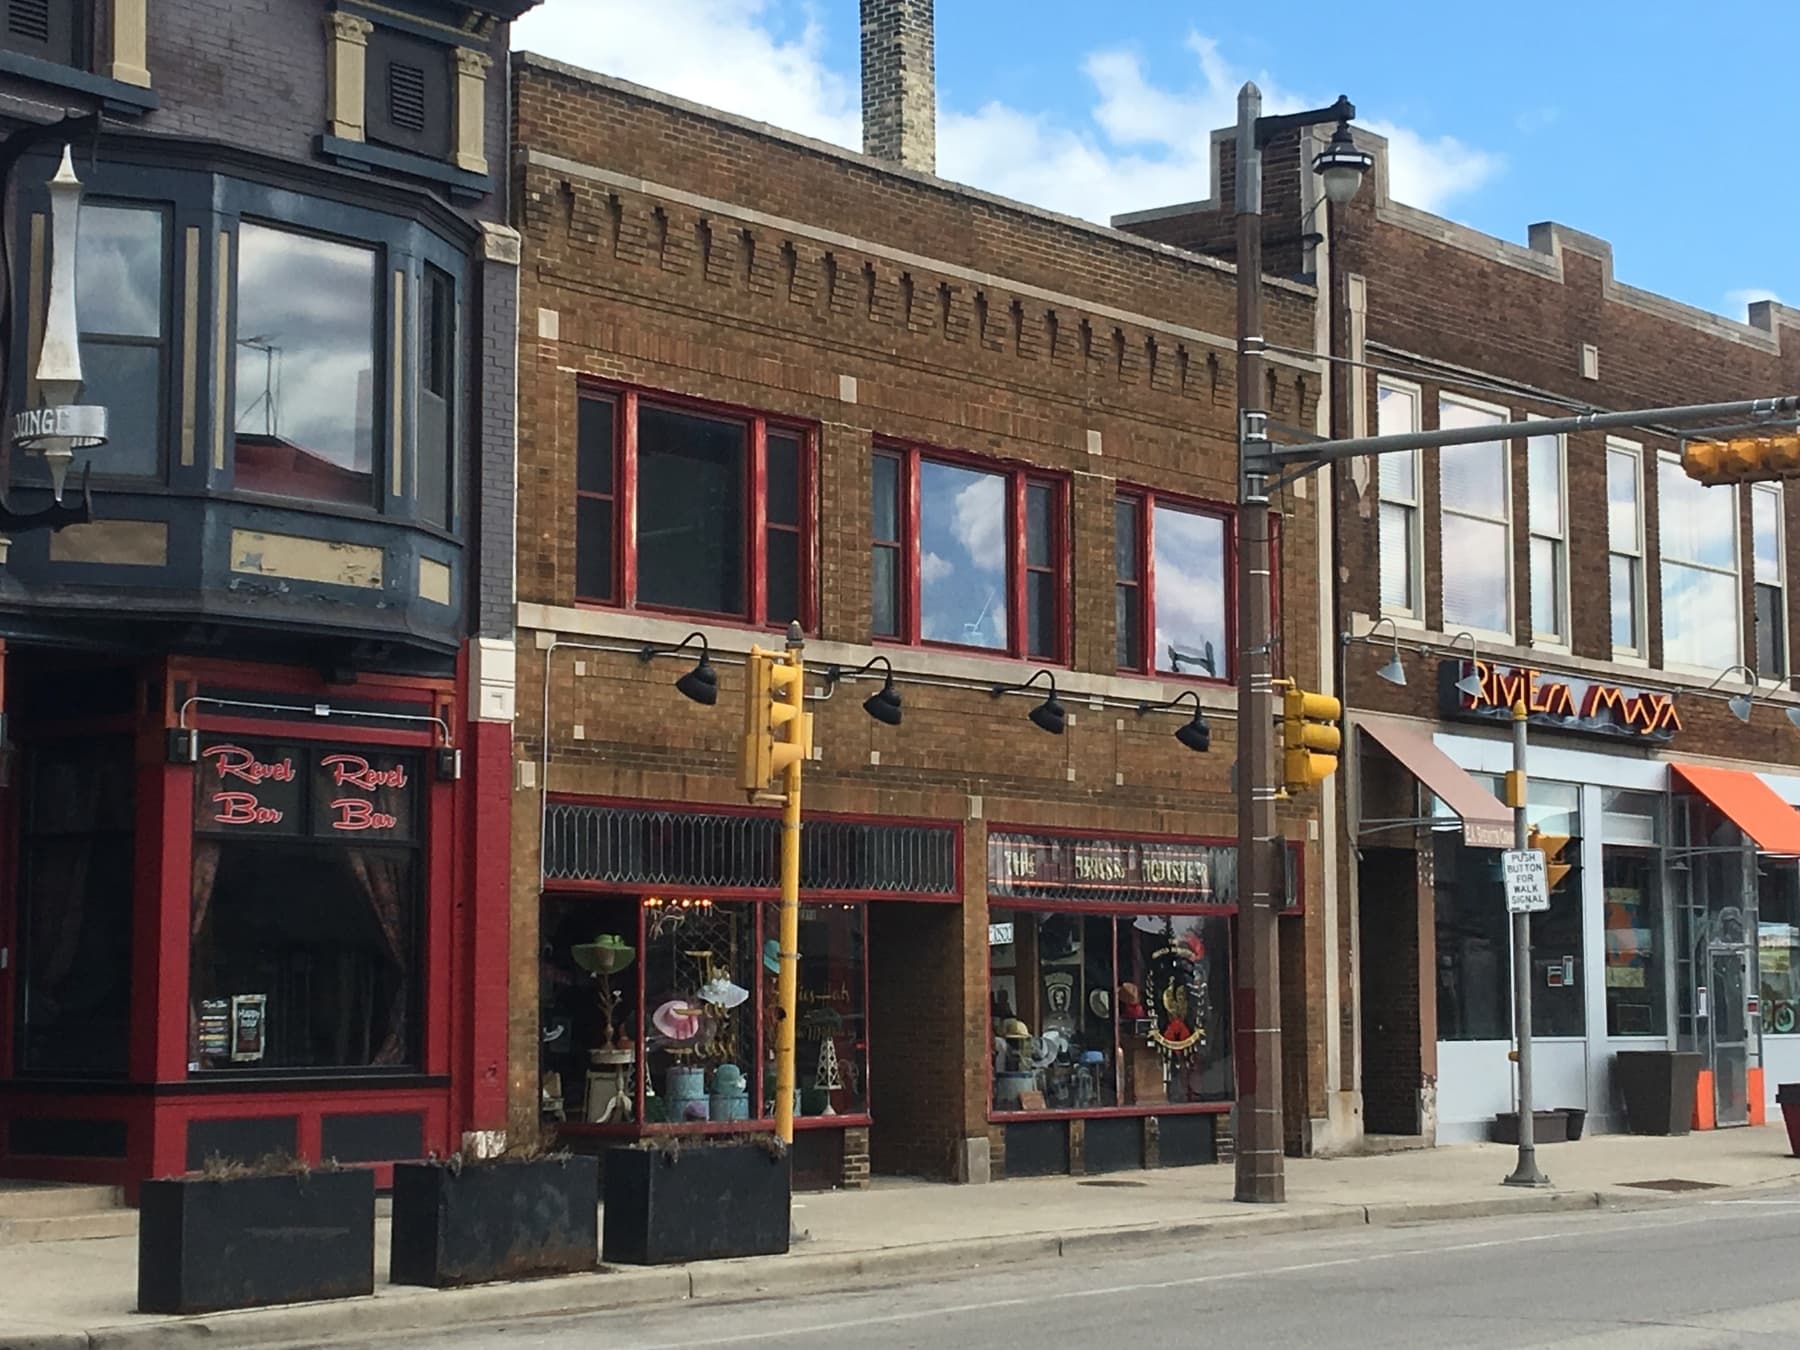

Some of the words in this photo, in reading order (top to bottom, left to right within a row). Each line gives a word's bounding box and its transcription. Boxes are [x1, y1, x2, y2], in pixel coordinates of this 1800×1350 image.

[202, 744, 296, 785] Revel
[321, 754, 408, 791] Revel
[213, 792, 283, 824] Bar
[330, 798, 397, 830] Bar
[1004, 851, 1036, 877] THE
[1511, 852, 1536, 862] PUSH
[1507, 863, 1543, 873] BUTTON
[1516, 874, 1534, 883] FOR
[1513, 884, 1539, 894] WALK
[1511, 894, 1544, 905] SIGNAL
